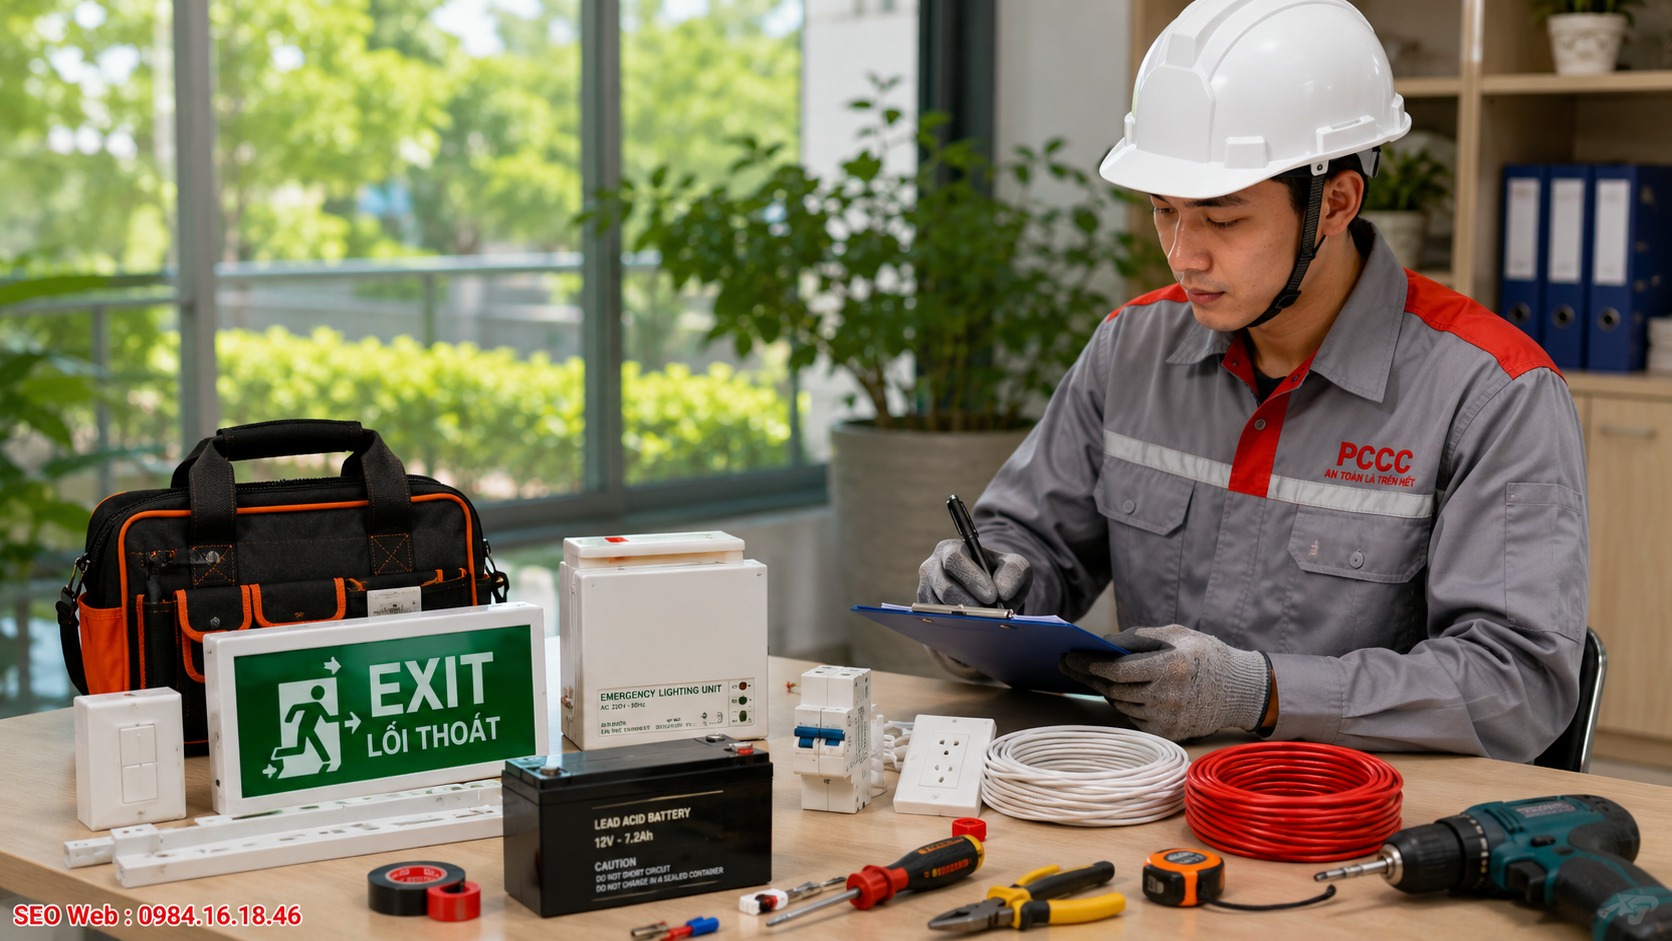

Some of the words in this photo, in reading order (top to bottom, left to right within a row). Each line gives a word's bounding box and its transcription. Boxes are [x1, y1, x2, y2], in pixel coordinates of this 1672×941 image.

[1336, 441, 1414, 474] PCCC
[1324, 468, 1338, 479] AN
[369, 651, 494, 718] EXIT
[600, 689, 656, 702] EMERGENCY
[658, 686, 699, 697] LIGHTING
[701, 684, 722, 694] UNIT
[415, 712, 500, 750] THOÁT
[594, 818, 620, 831] LEAD
[622, 814, 646, 827] ACID
[648, 807, 692, 823] BATTERY
[594, 835, 614, 849] 12V
[624, 830, 654, 844] 7.2Ah
[594, 857, 637, 872] CAUTION
[595, 874, 606, 883] DO
[595, 884, 606, 893] DO
[607, 881, 621, 891] NOT
